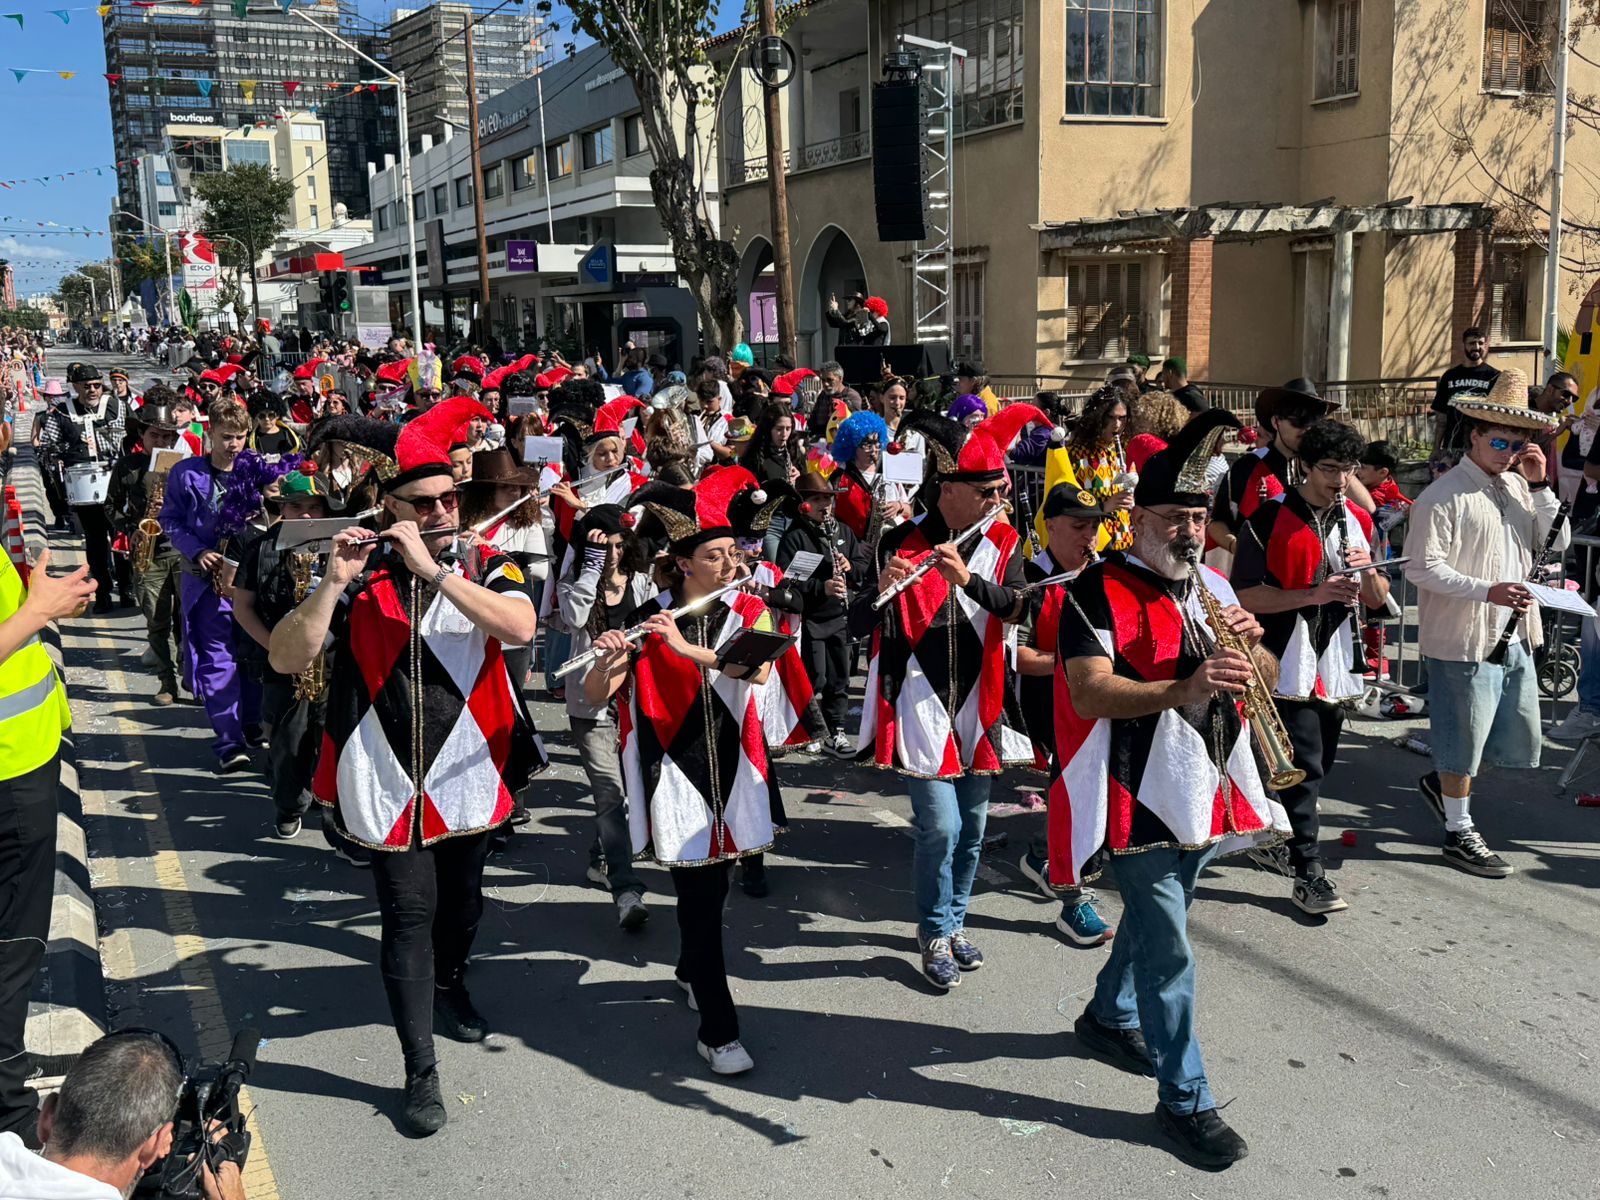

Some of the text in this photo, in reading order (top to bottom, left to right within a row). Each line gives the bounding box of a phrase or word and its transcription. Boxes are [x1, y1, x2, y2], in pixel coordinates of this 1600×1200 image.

[170, 112, 214, 124] boutique
[754, 332, 779, 343] Beaut
[1454, 378, 1490, 389] SANDER
